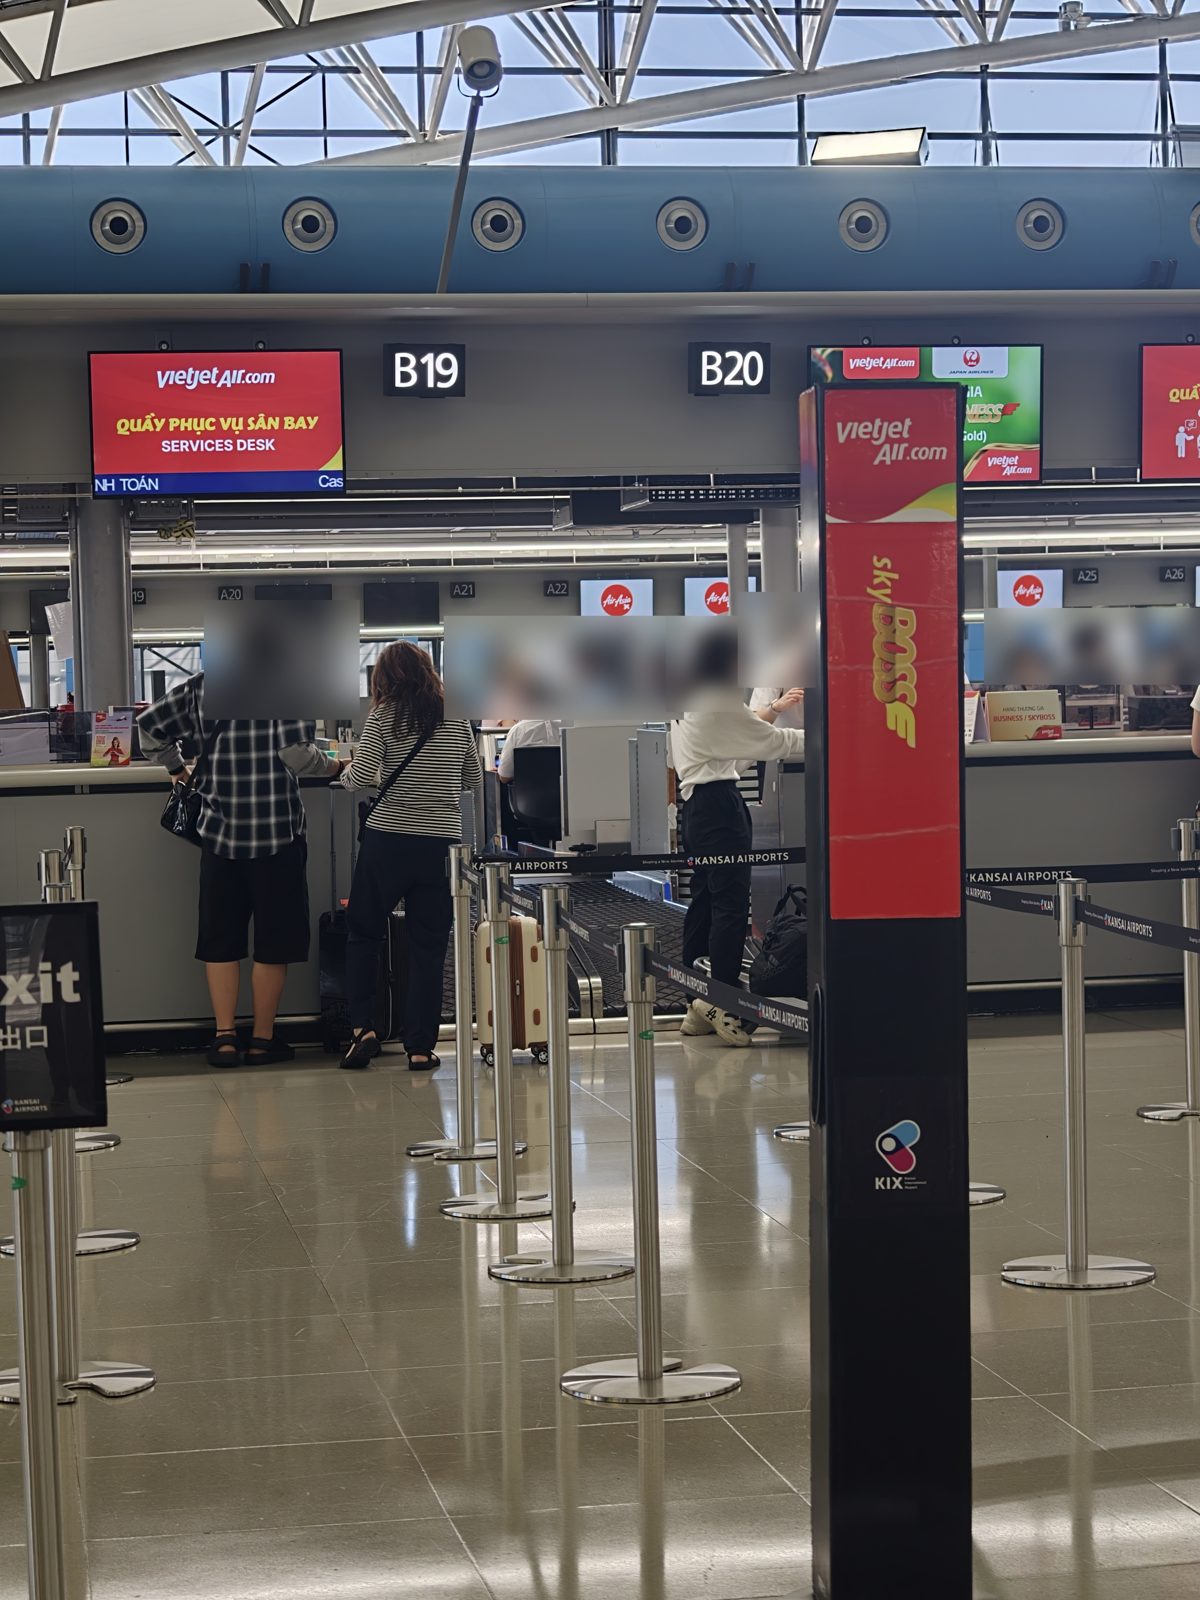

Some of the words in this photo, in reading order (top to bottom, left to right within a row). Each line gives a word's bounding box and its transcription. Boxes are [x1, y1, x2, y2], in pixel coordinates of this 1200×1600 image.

[394, 353, 459, 389] B19
[701, 351, 764, 386] B20
[967, 386, 983, 398] IA
[169, 416, 216, 435] PHỤC
[220, 417, 244, 435] VỤ
[246, 413, 280, 431] SÂN
[283, 415, 319, 431] BAY
[161, 439, 233, 453] SERVICES
[237, 438, 275, 452] DESK
[873, 443, 948, 466] Air.com
[94, 478, 115, 492] NH
[119, 477, 159, 492] TOÁN
[318, 475, 344, 488] Cas
[1078, 571, 1097, 582] A25
[1165, 568, 1184, 580] A26
[132, 590, 145, 602] 19
[220, 588, 242, 600] A20
[453, 584, 474, 596] A21
[547, 583, 568, 595] A22
[993, 714, 1023, 722] BUSINESS
[1028, 713, 1056, 721] SKYBOSS
[695, 854, 734, 865] KANSAI
[736, 851, 790, 863] AIRPORTS
[515, 861, 568, 871] AIRPORTS
[969, 872, 1013, 883] KANSAI
[1016, 870, 1073, 882] AIRPORTS
[969, 886, 992, 901] AIRPORTS
[1107, 915, 1127, 930] KANSAI
[1127, 920, 1153, 938] AIRPORTS
[0, 961, 81, 1005] xit
[670, 967, 686, 987] KANSAI
[686, 974, 709, 996] AIRPORTS
[762, 1004, 782, 1024] KANSAI
[782, 1010, 809, 1033] AIRPORTS
[0, 1025, 49, 1050] 出口
[875, 1177, 903, 1190] KIX
